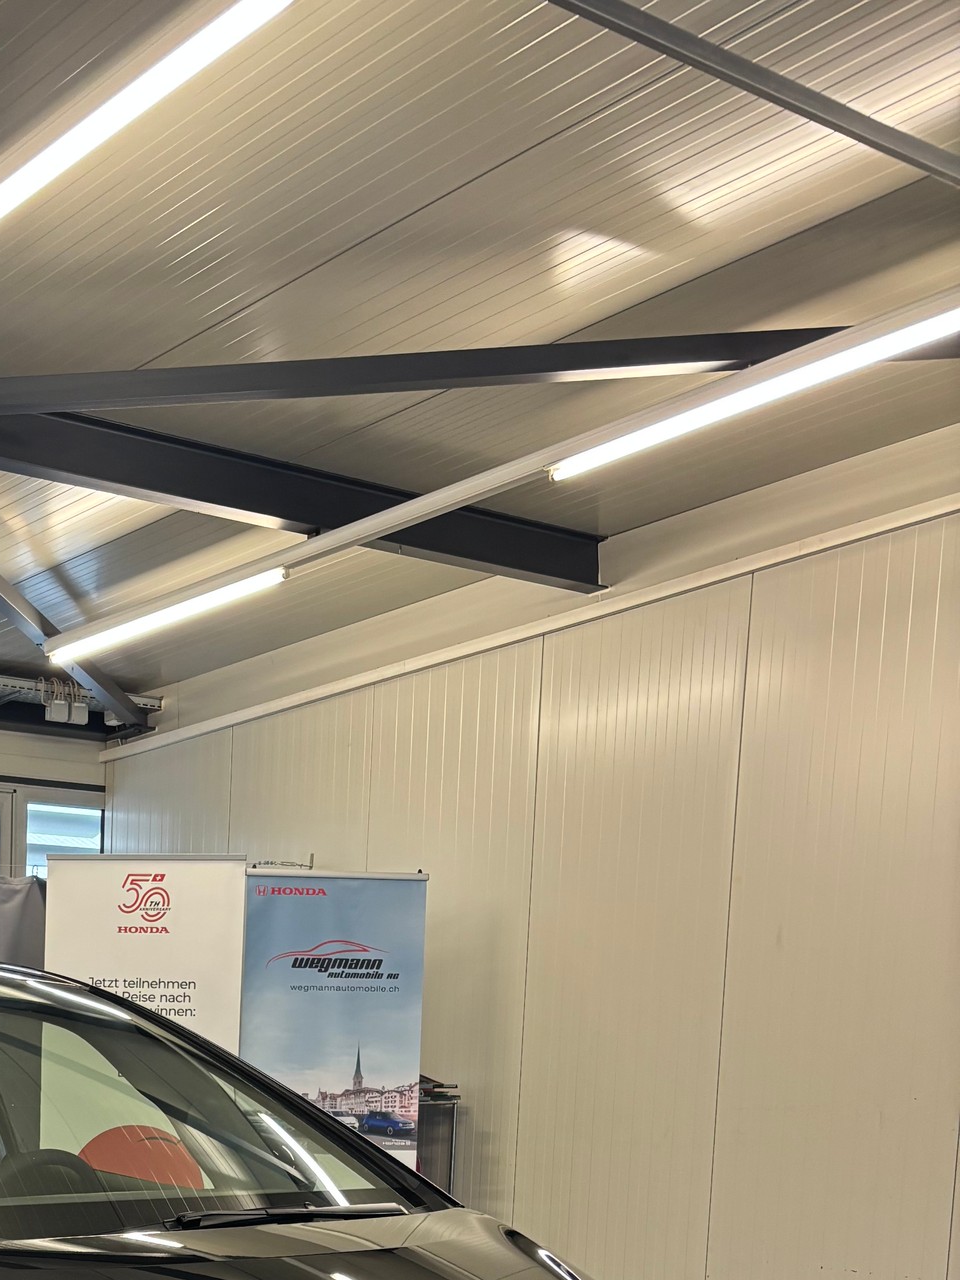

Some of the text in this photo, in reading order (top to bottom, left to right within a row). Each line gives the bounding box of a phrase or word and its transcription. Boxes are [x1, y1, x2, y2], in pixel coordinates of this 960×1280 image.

[269, 886, 328, 896] HONDA
[118, 874, 170, 923] 50
[117, 926, 170, 934] HONDA
[291, 957, 384, 973] wegmann
[88, 977, 196, 990] Jetzt teilnehmen
[290, 984, 400, 994] wegmannautomobile.ch
[122, 991, 156, 1003] Reise
[159, 992, 191, 1003] nach
